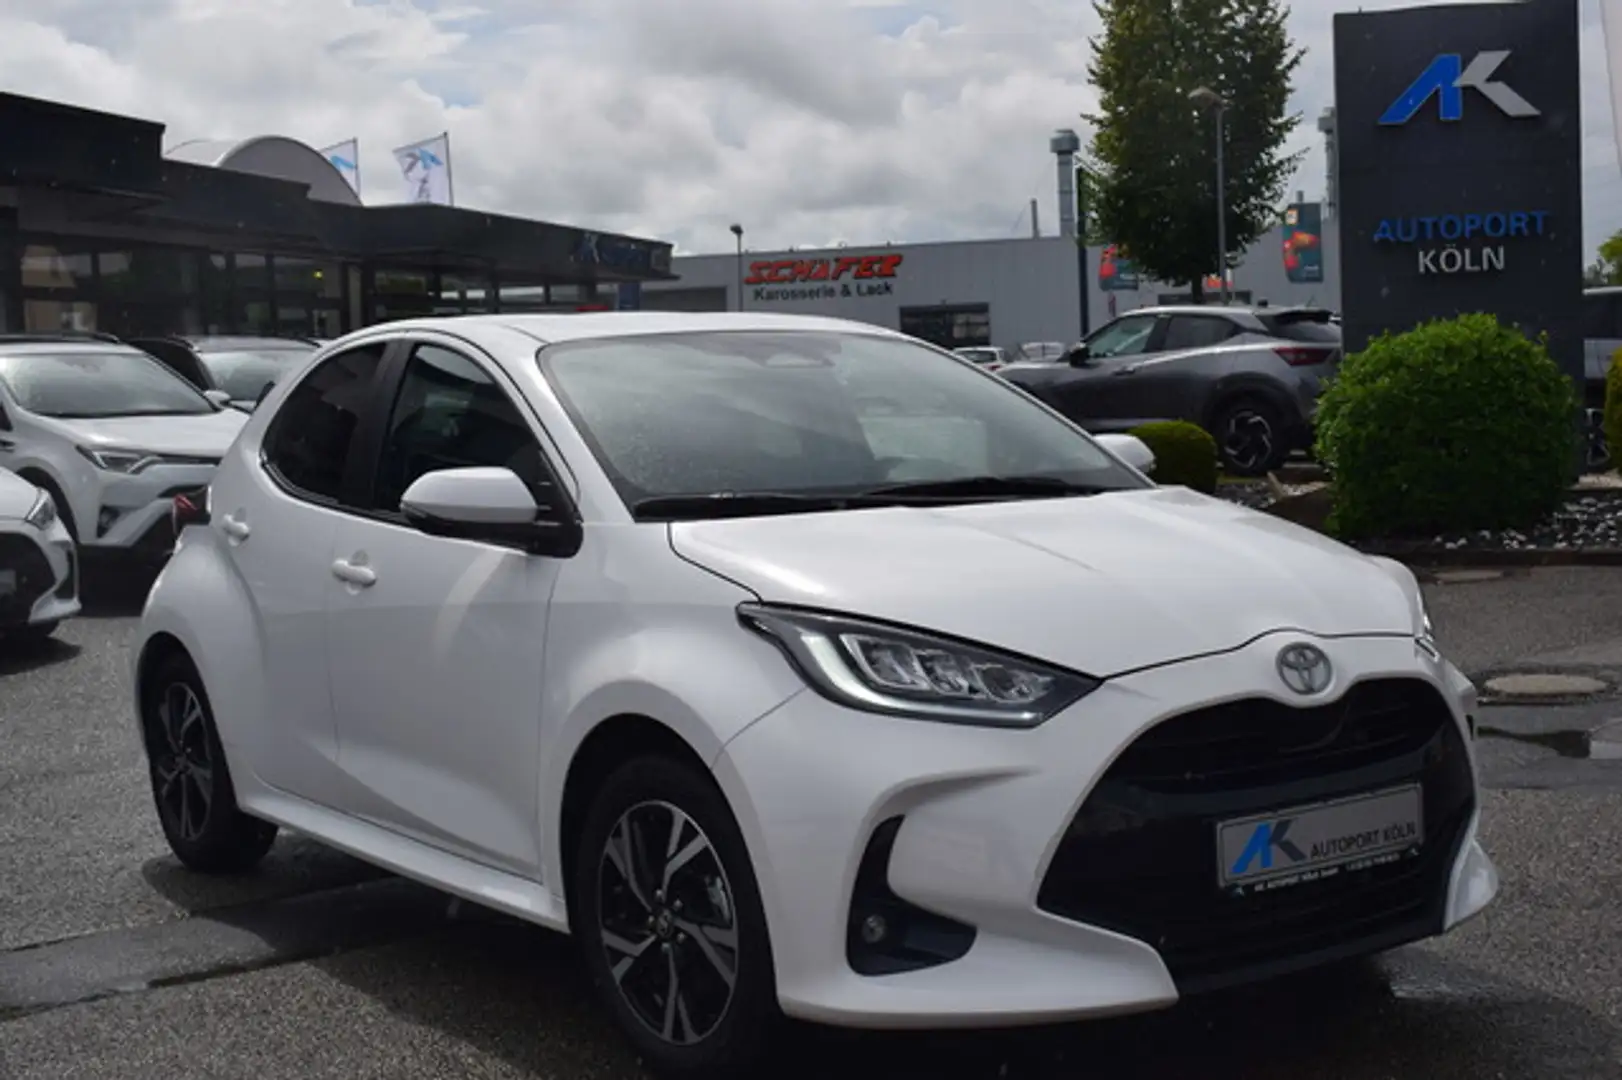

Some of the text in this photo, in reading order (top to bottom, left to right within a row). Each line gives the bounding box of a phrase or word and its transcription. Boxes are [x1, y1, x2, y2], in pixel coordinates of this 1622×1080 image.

[1374, 211, 1548, 242] AUTOPORT
[1418, 244, 1505, 274] KÖLN
[753, 281, 894, 301] Karosserie & Lack
[1310, 829, 1380, 859] AUTOPORT
[1383, 821, 1417, 841] KÖLN
